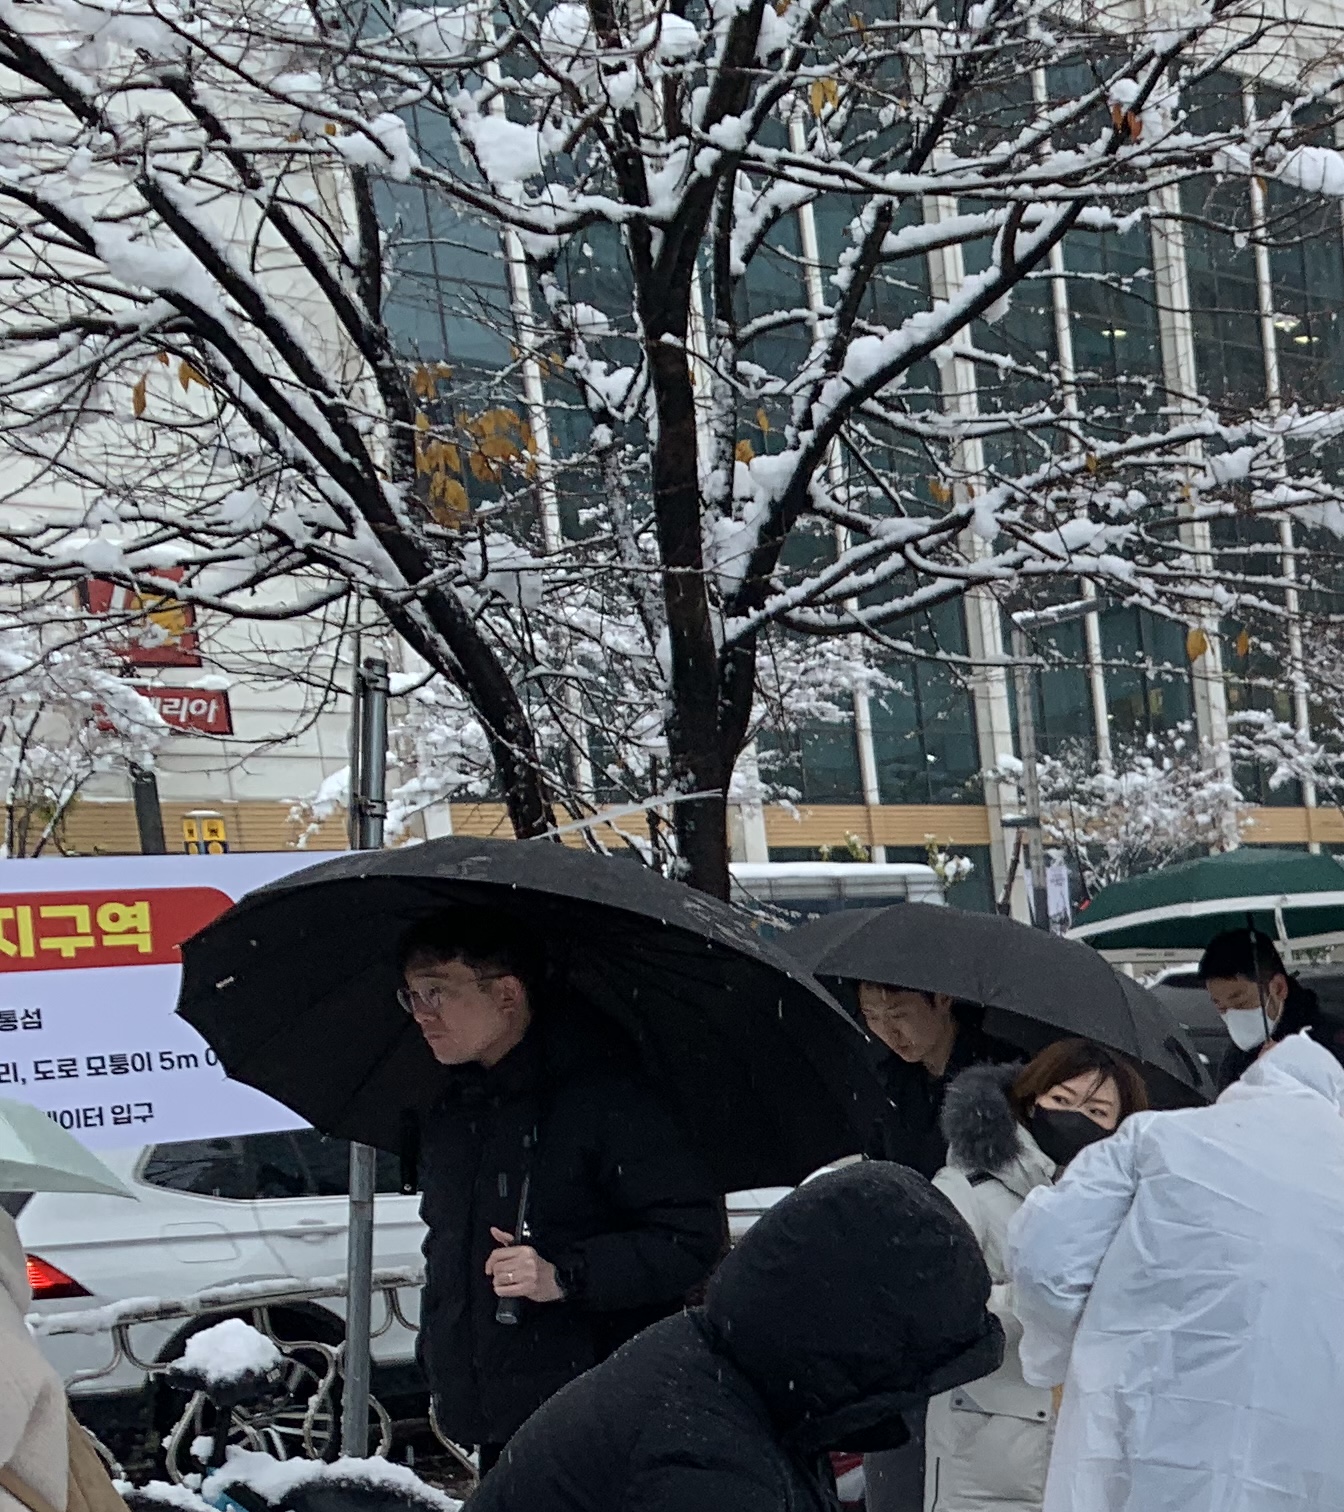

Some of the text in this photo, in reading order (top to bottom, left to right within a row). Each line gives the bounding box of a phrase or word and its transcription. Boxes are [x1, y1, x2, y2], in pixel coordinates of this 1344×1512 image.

[0, 901, 152, 959] 지구역
[33, 1056, 79, 1082] 도로
[86, 1051, 153, 1077] 모퉁이
[160, 1050, 199, 1071] 5m
[111, 1102, 155, 1125] 입구
